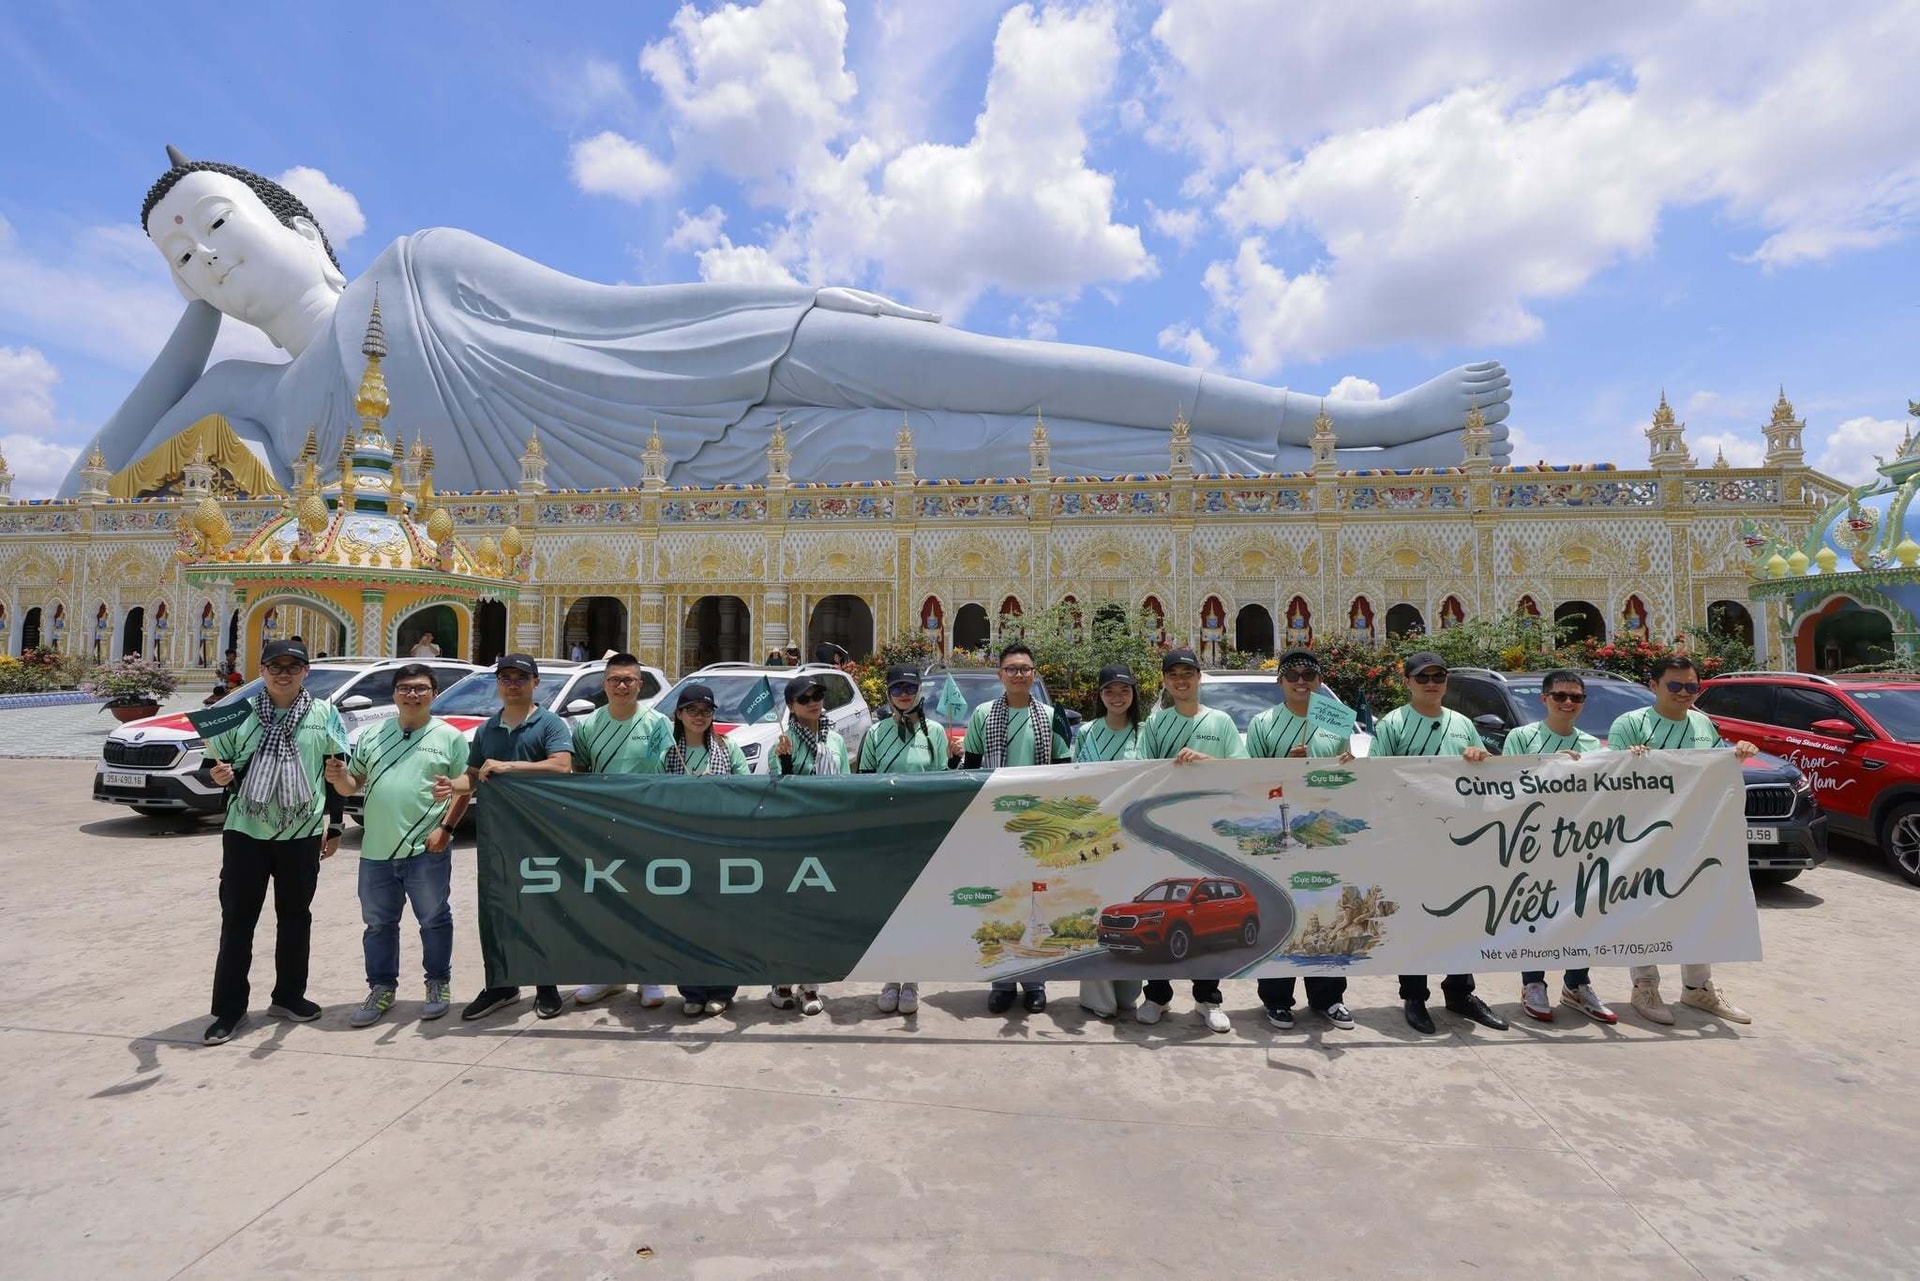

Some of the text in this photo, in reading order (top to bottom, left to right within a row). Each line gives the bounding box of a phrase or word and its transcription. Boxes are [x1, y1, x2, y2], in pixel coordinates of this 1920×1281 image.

[198, 709, 247, 729] SKODA
[300, 723, 327, 731] SKODA
[1196, 734, 1221, 742] SKODA
[416, 746, 443, 756] SKODA
[1455, 770, 1675, 800] Cùng Škoda Kushaq
[1449, 801, 1674, 868] Vẽ trọn
[519, 856, 838, 896] SKODA
[974, 892, 993, 900] Nam
[1421, 856, 1723, 937] Việt Nam
[1480, 940, 1673, 960] Nét vẽ Phương Nam, 16-17/05/2026
